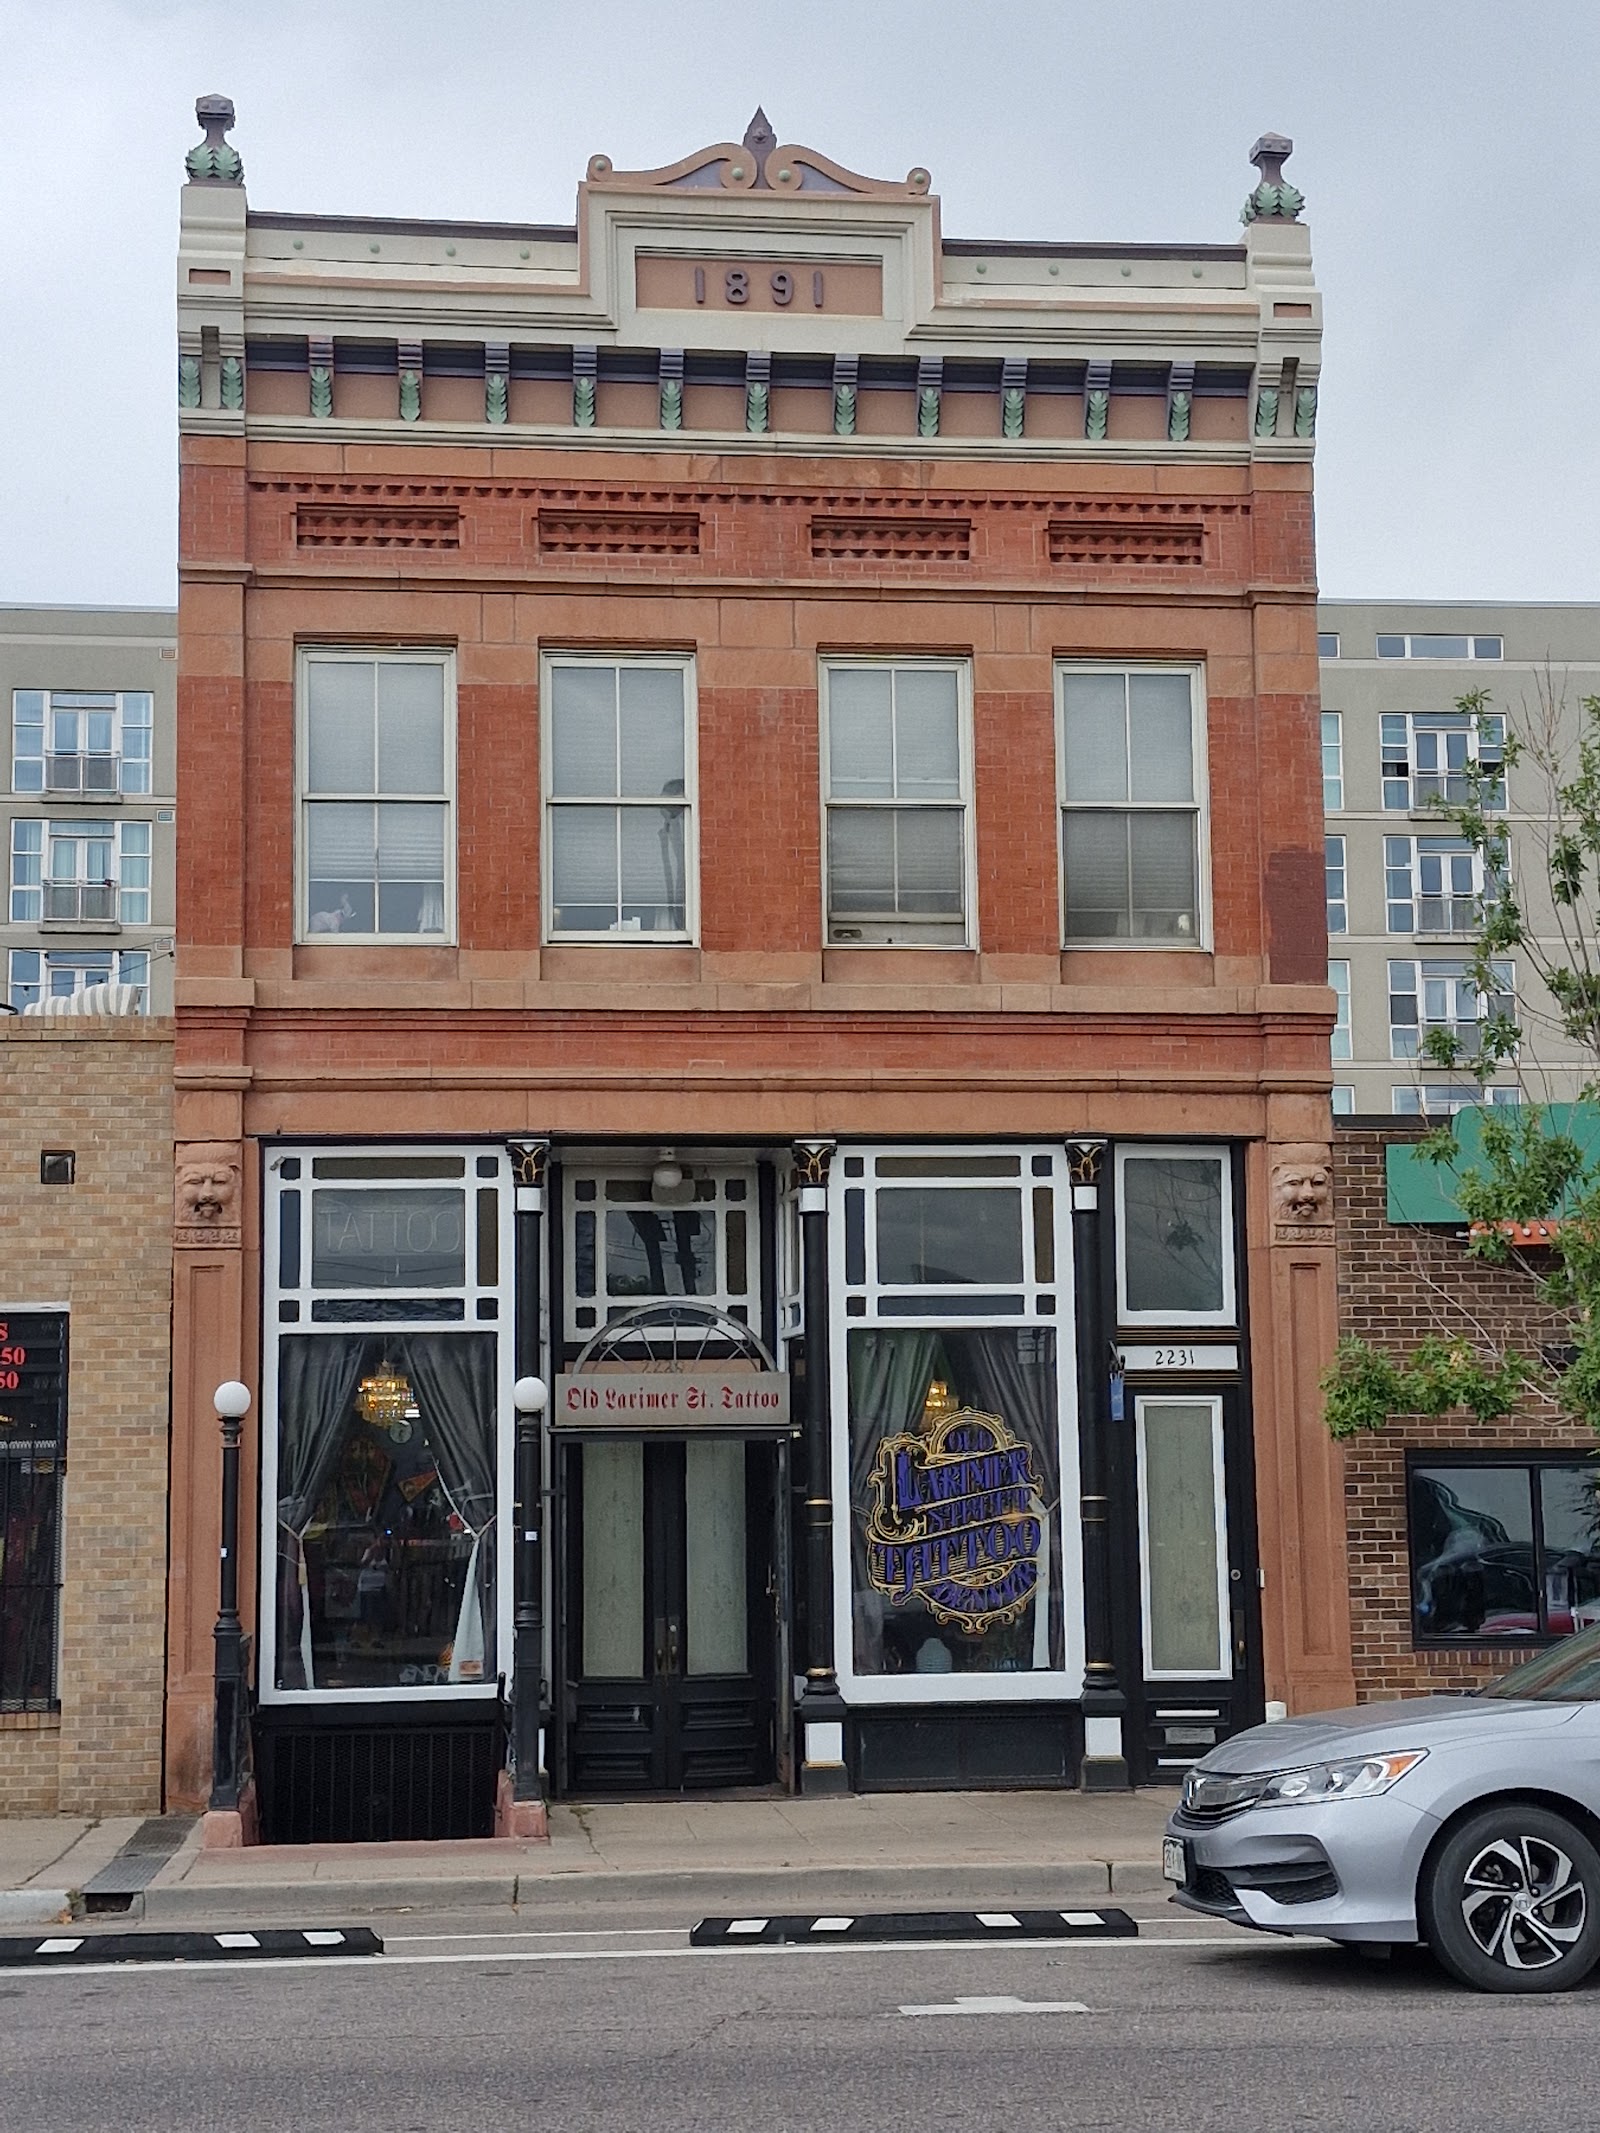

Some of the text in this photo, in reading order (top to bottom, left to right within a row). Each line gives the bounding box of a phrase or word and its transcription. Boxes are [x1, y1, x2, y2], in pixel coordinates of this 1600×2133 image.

[693, 265, 825, 308] 1891
[318, 1208, 461, 1253] TATTOO
[1155, 1349, 1195, 1366] 2231
[566, 1386, 780, 1410] Old Larimer St. Tattoo
[947, 1428, 994, 1451] OLD
[896, 1450, 1032, 1512] LARIMER
[926, 1487, 1032, 1533] STREET
[873, 1519, 1041, 1604] TATTOO
[931, 1561, 1039, 1613] DENVER
